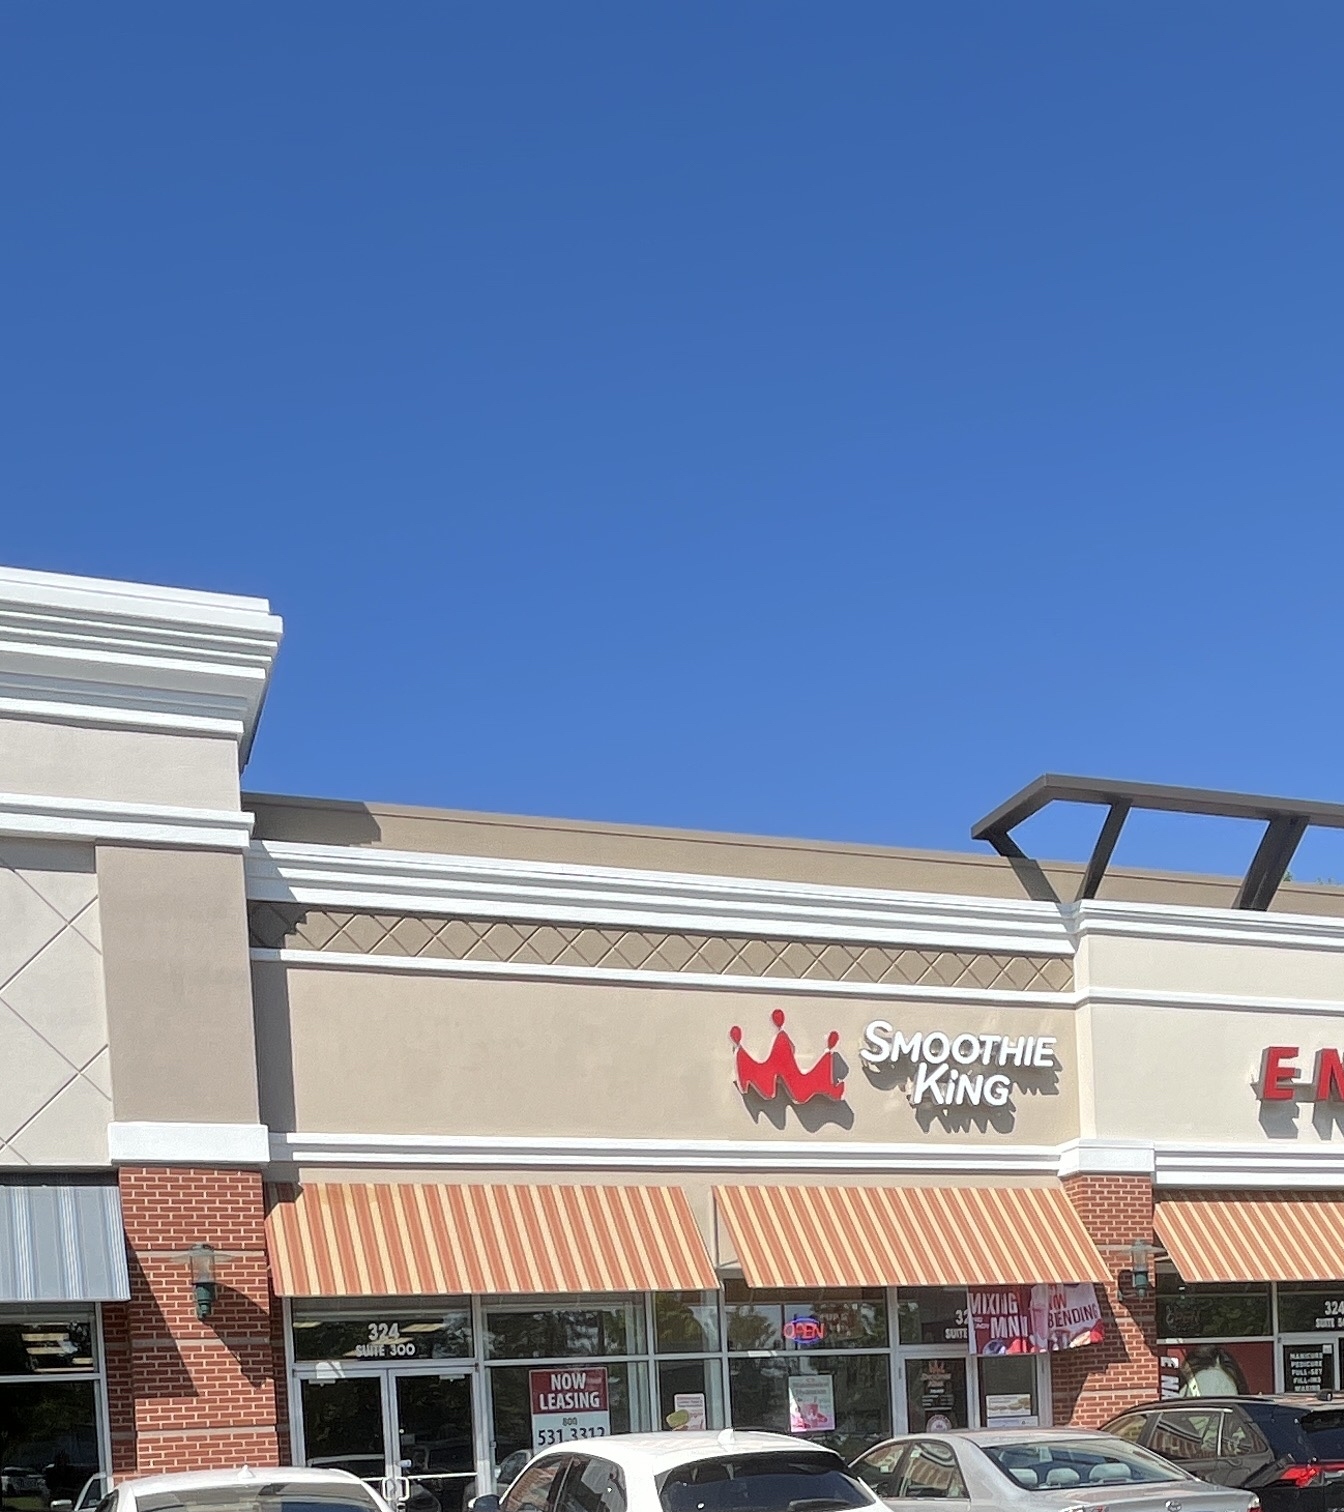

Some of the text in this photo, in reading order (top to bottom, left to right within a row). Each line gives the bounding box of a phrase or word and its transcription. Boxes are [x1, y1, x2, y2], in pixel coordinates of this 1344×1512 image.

[860, 1019, 1058, 1068] SMOOTHIE
[1260, 1045, 1301, 1102] E
[367, 1322, 400, 1341] 324
[783, 1321, 825, 1340] OPEN
[355, 1342, 416, 1358] SUITE 300
[550, 1372, 587, 1391] NOW
[539, 1391, 601, 1411] LEASING
